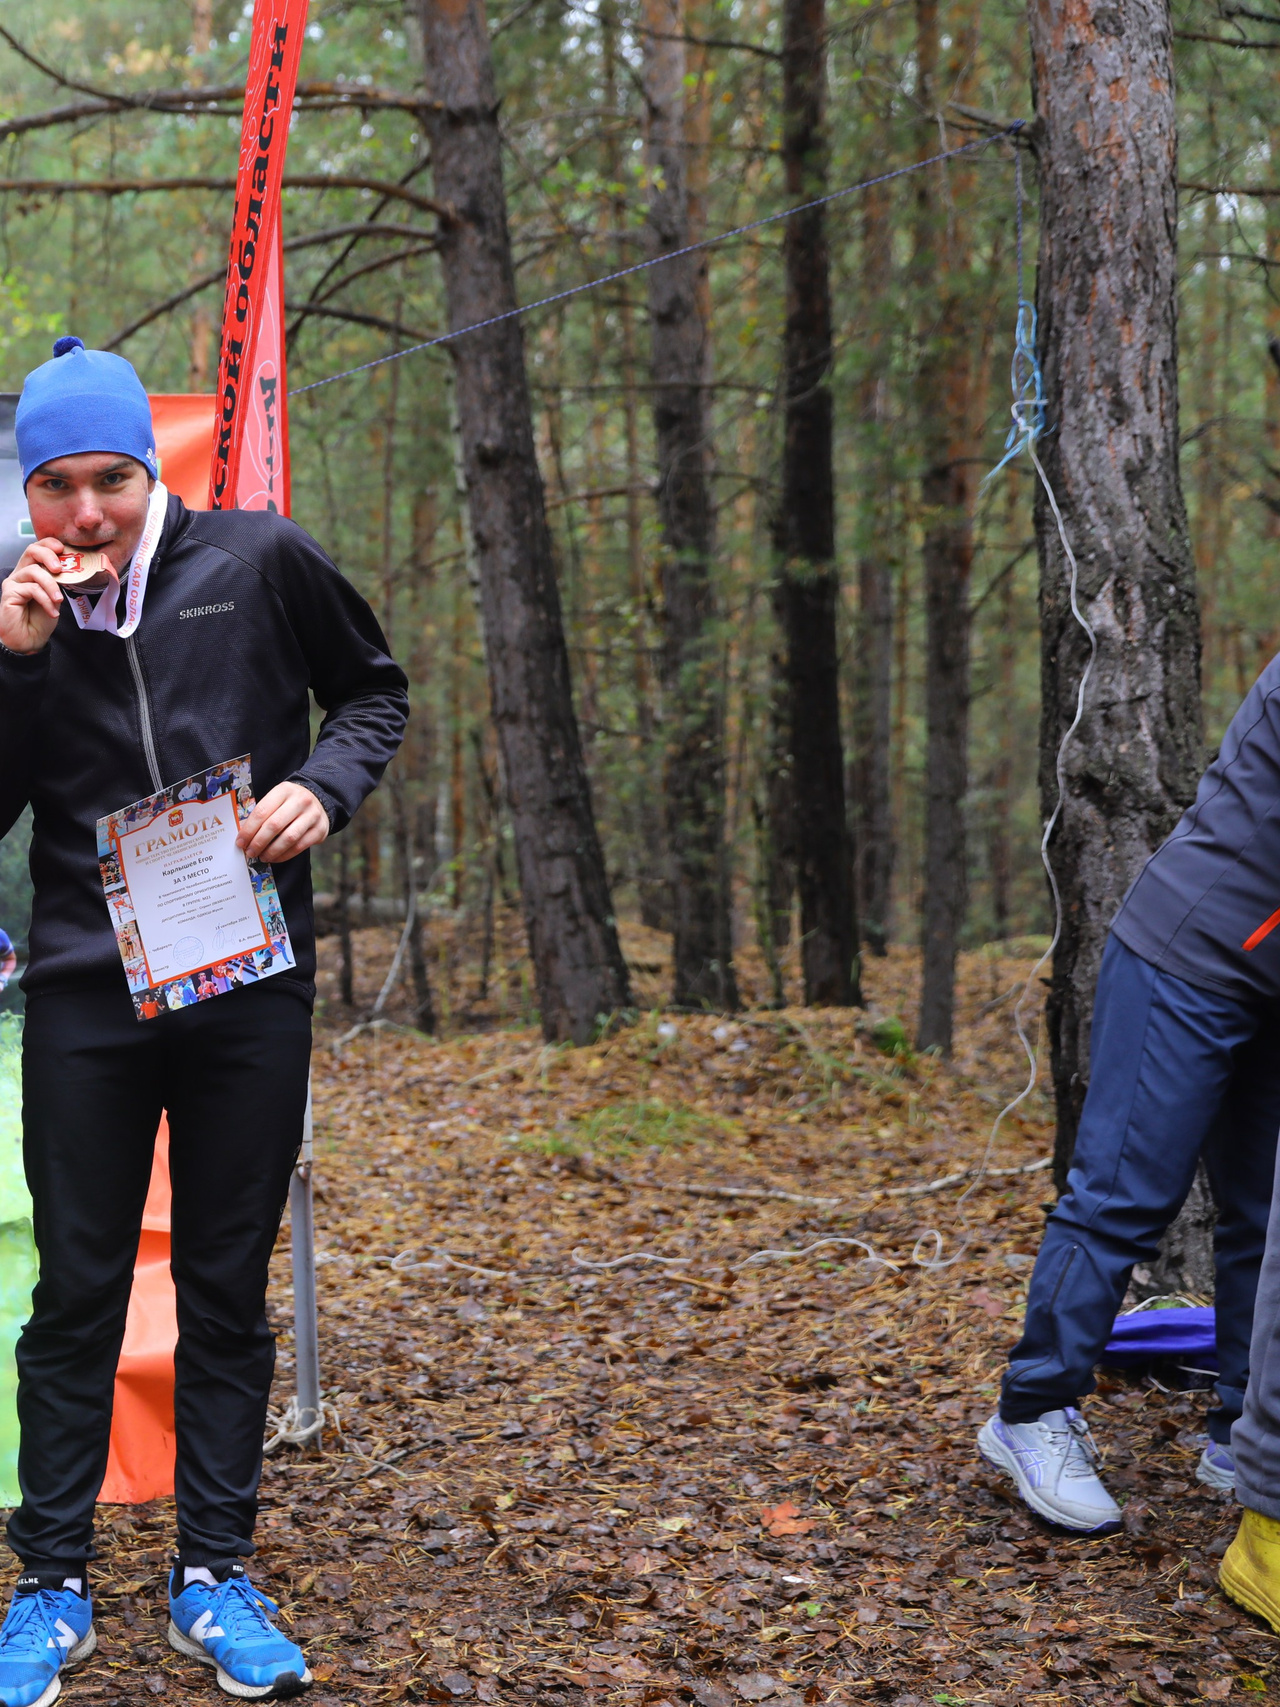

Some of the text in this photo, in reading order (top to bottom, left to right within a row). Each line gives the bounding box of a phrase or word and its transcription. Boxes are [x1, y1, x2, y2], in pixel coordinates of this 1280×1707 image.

[236, 22, 288, 323] области
[179, 601, 235, 620] SKIKROSS
[135, 814, 223, 857] ГРАМОТА
[162, 854, 214, 876] Карлышев Егор
[187, 868, 209, 879] МЕСТО
